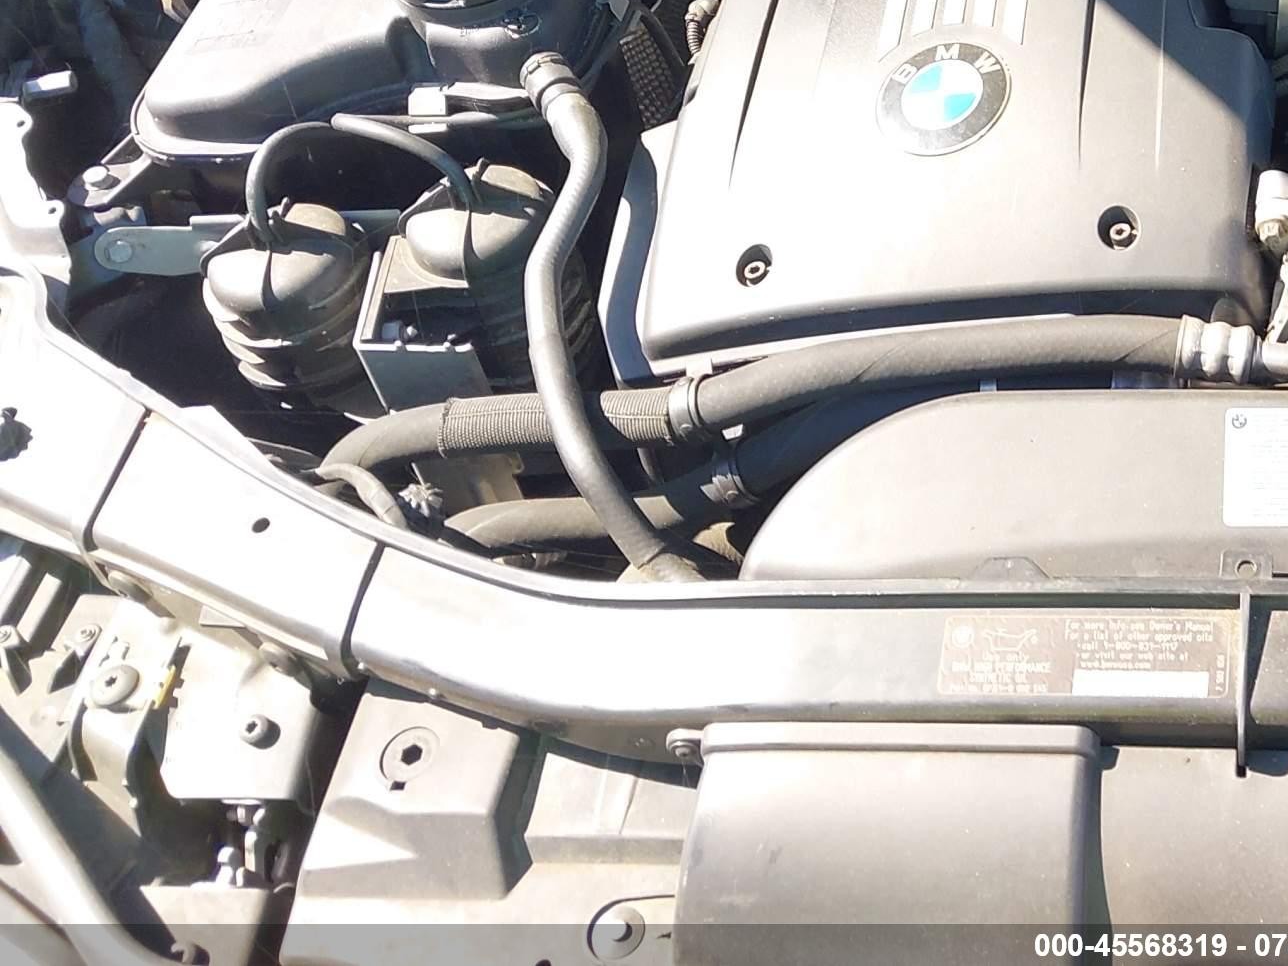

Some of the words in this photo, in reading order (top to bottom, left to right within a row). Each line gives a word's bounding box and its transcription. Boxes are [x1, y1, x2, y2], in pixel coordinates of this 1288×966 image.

[891, 43, 1001, 85] BMW
[1185, 621, 1214, 634] Manual
[1154, 632, 1193, 643] approved
